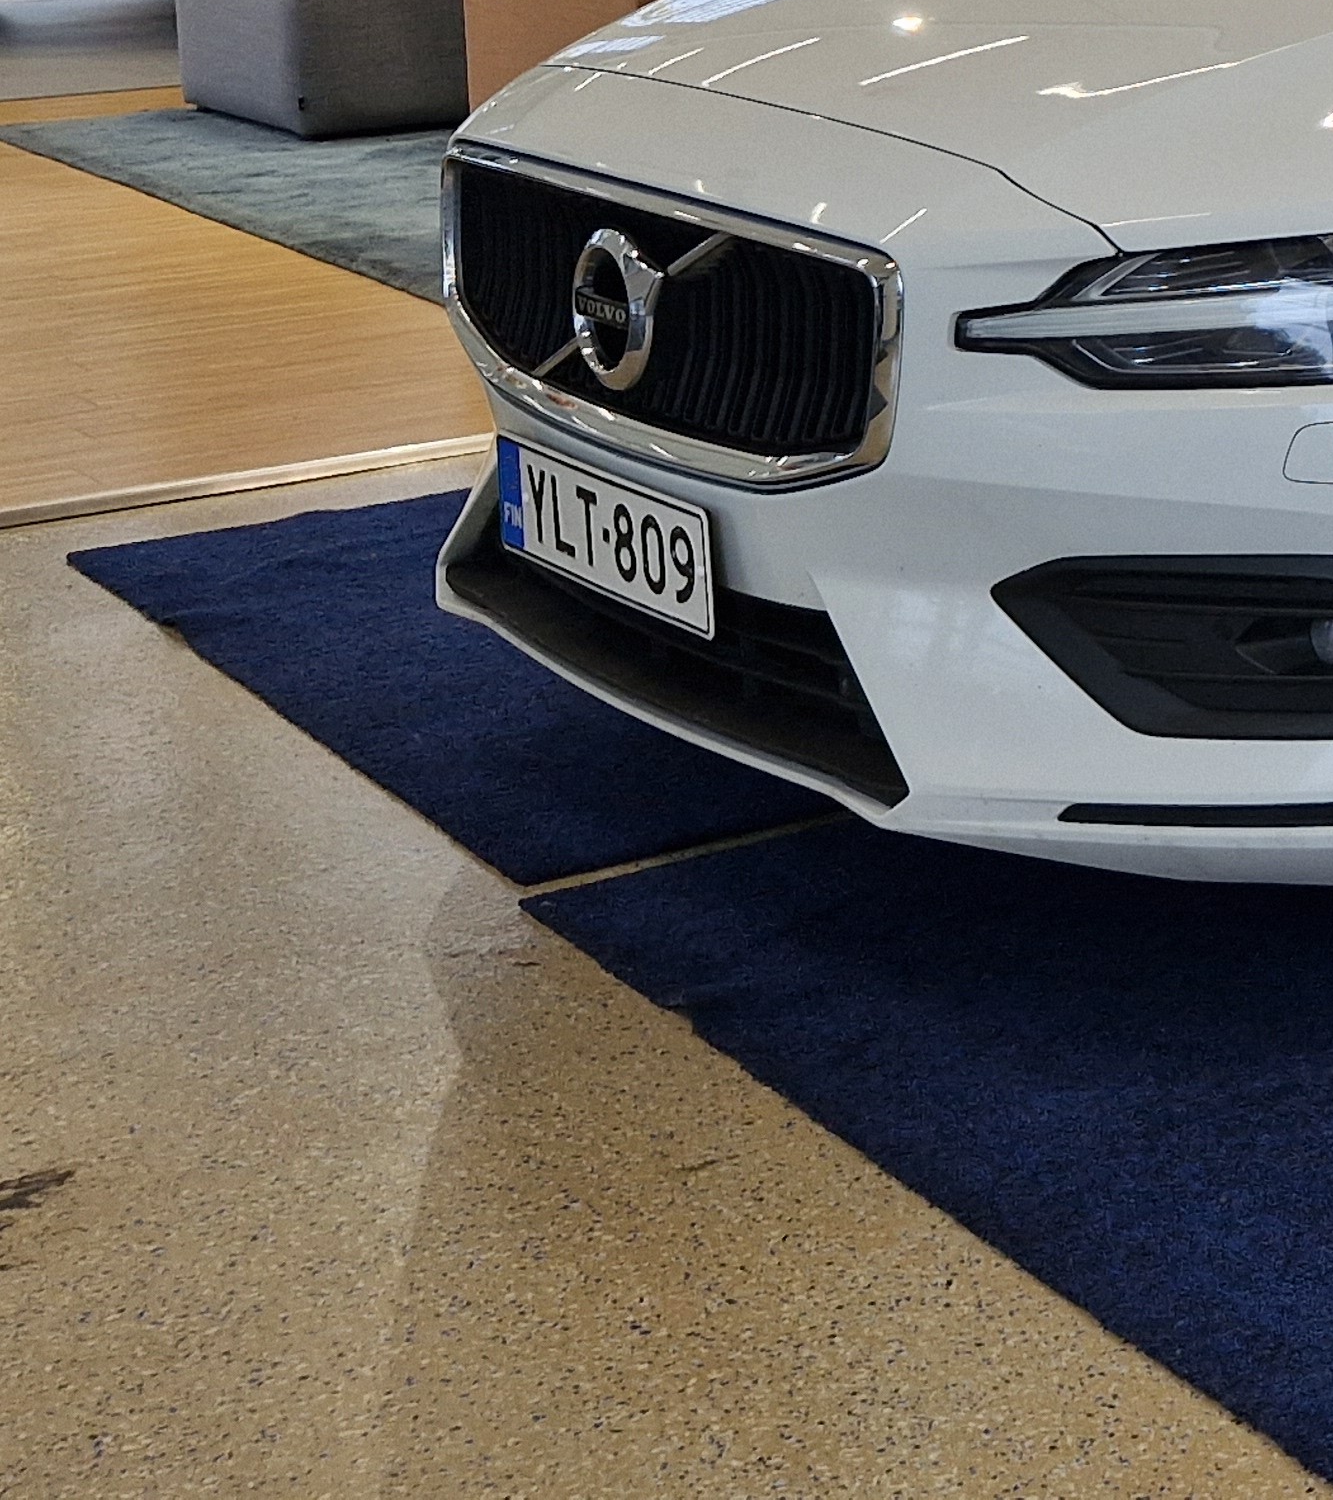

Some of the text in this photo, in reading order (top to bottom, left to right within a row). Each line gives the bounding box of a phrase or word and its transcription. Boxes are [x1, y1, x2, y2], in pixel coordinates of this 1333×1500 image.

[577, 295, 627, 323] VOLVO
[503, 501, 523, 530] FIN
[526, 463, 696, 604] YLT-809
